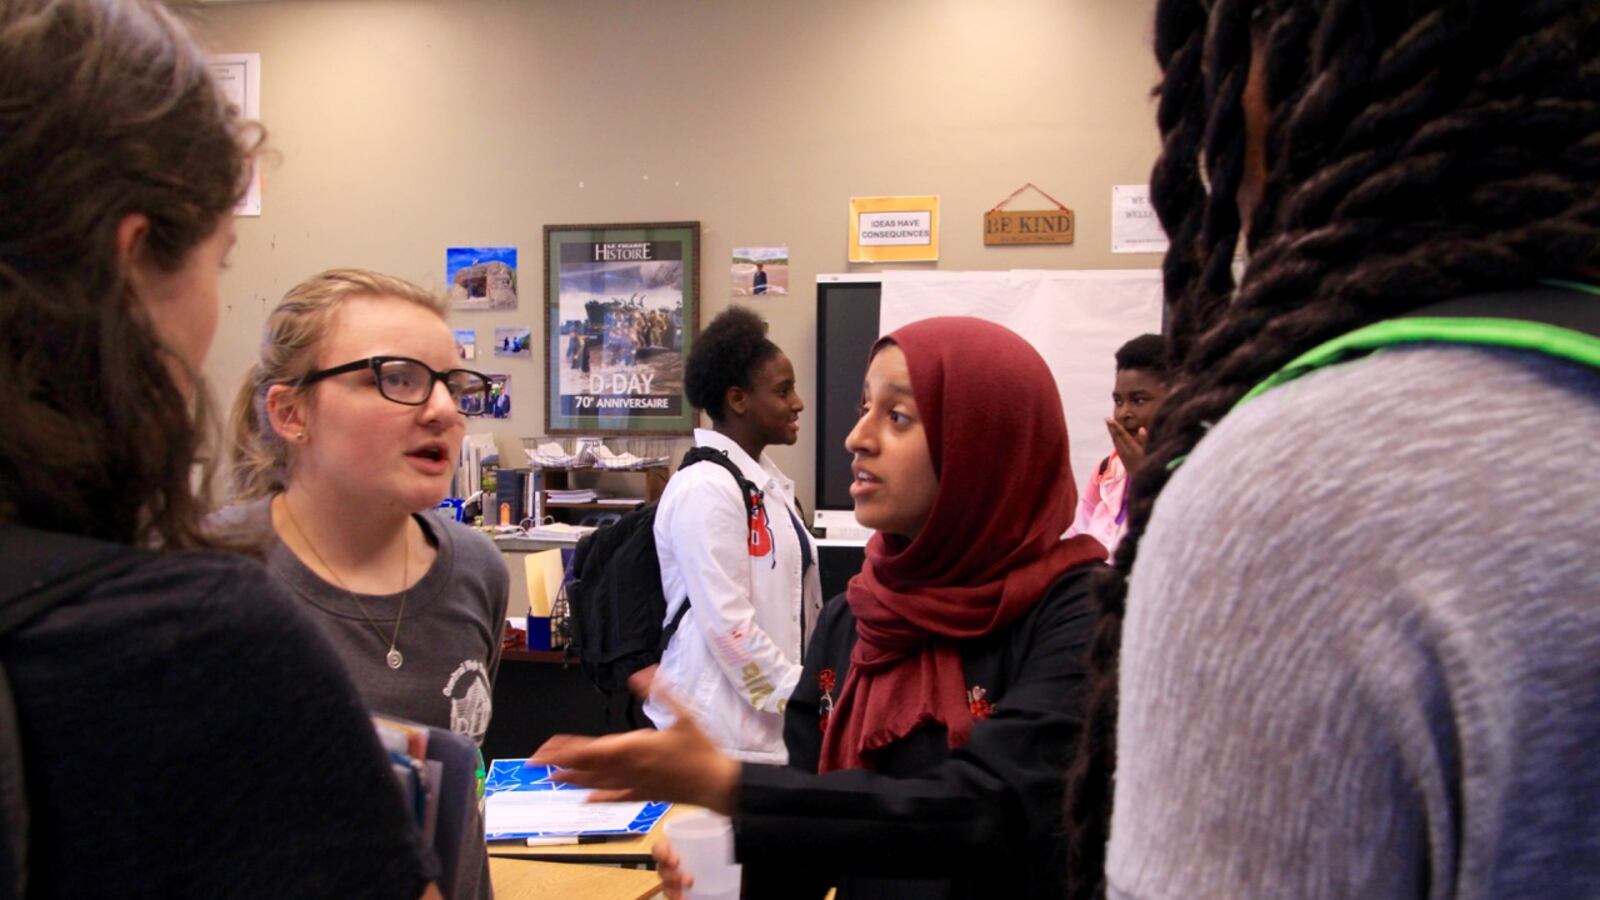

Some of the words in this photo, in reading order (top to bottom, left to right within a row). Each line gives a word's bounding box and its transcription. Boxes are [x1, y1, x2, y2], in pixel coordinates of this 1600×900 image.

[871, 219, 896, 228] IDEAS
[897, 218, 921, 227] HAVE
[986, 216, 1012, 234] BE
[1019, 215, 1071, 234] KIND
[861, 229, 930, 239] CONSEQUENCES
[595, 242, 652, 261] HISTOIRE
[589, 373, 655, 395] D-DAY
[596, 398, 669, 409] ANNIVERSAIRE
